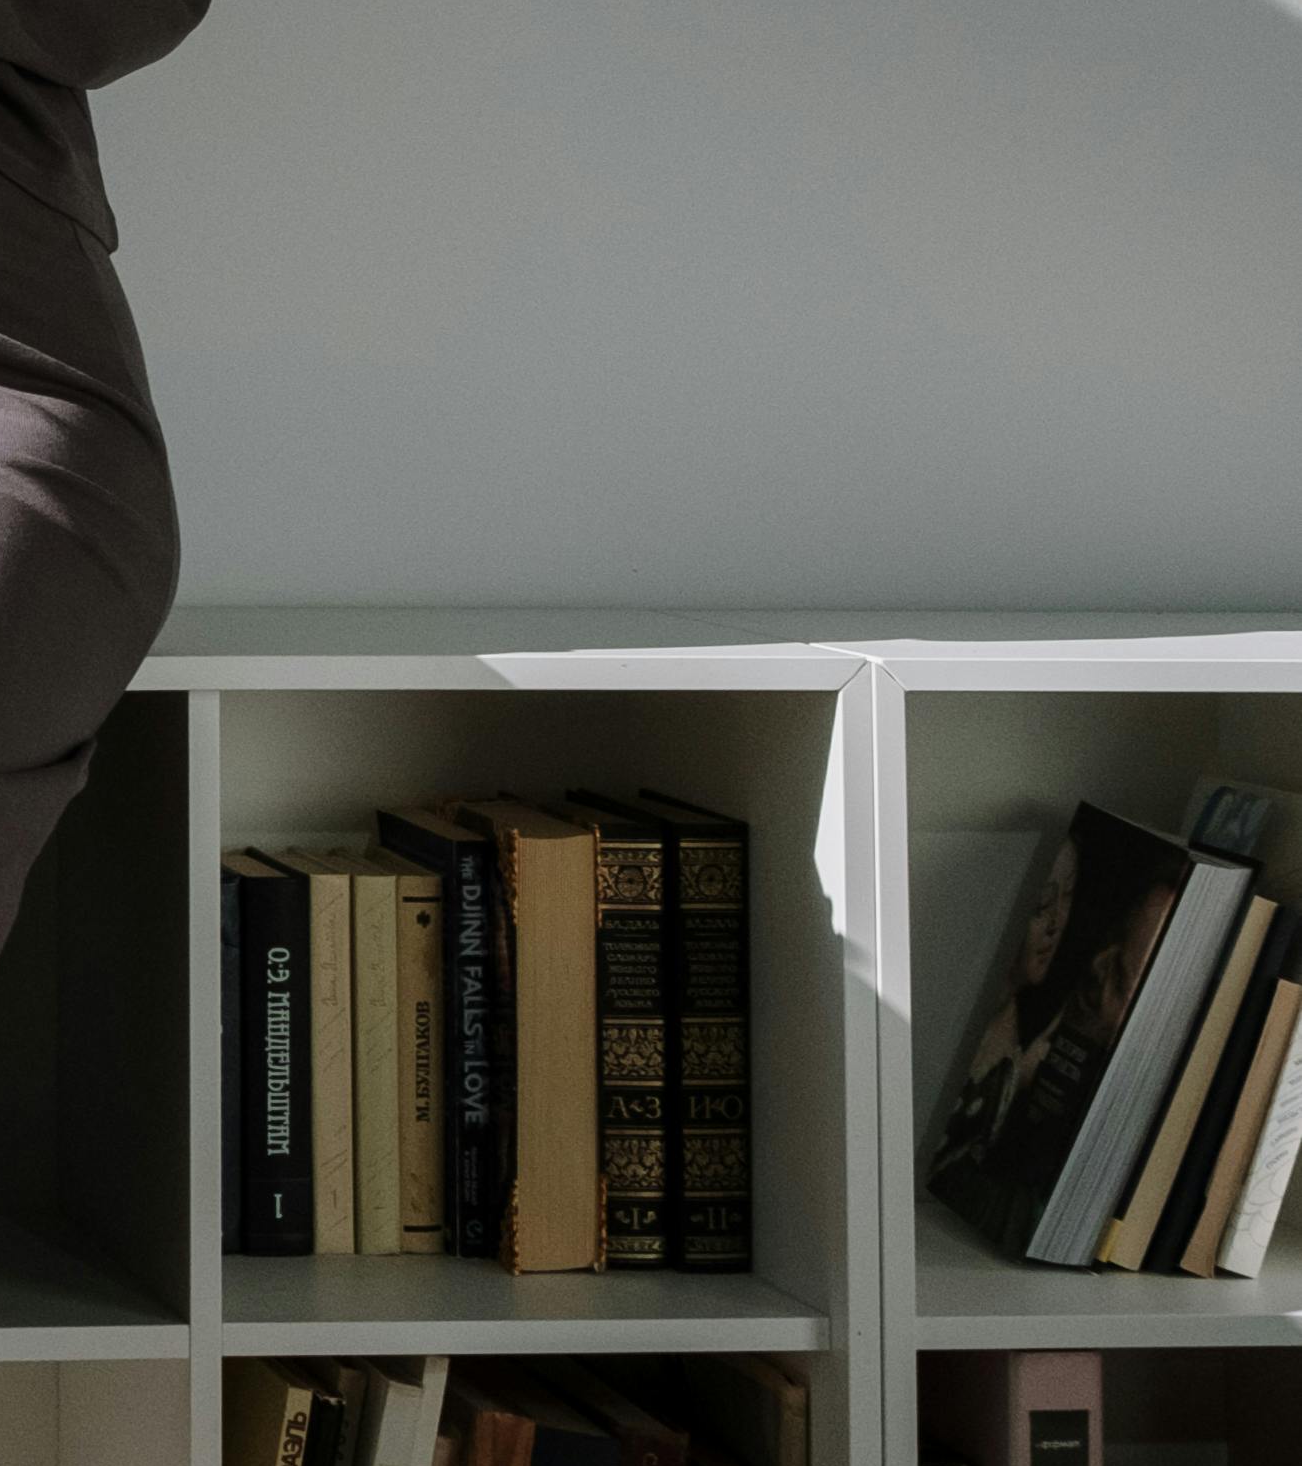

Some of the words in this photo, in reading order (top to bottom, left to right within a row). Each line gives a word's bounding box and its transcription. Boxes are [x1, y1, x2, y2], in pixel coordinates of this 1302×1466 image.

[460, 855, 474, 879] THE
[460, 885, 484, 956] DJINN
[462, 966, 484, 1035] FALLS
[265, 991, 291, 1157] МАНДЕЛЬШТАМ
[462, 1039, 475, 1054] IN
[464, 1060, 485, 1125] LOVE
